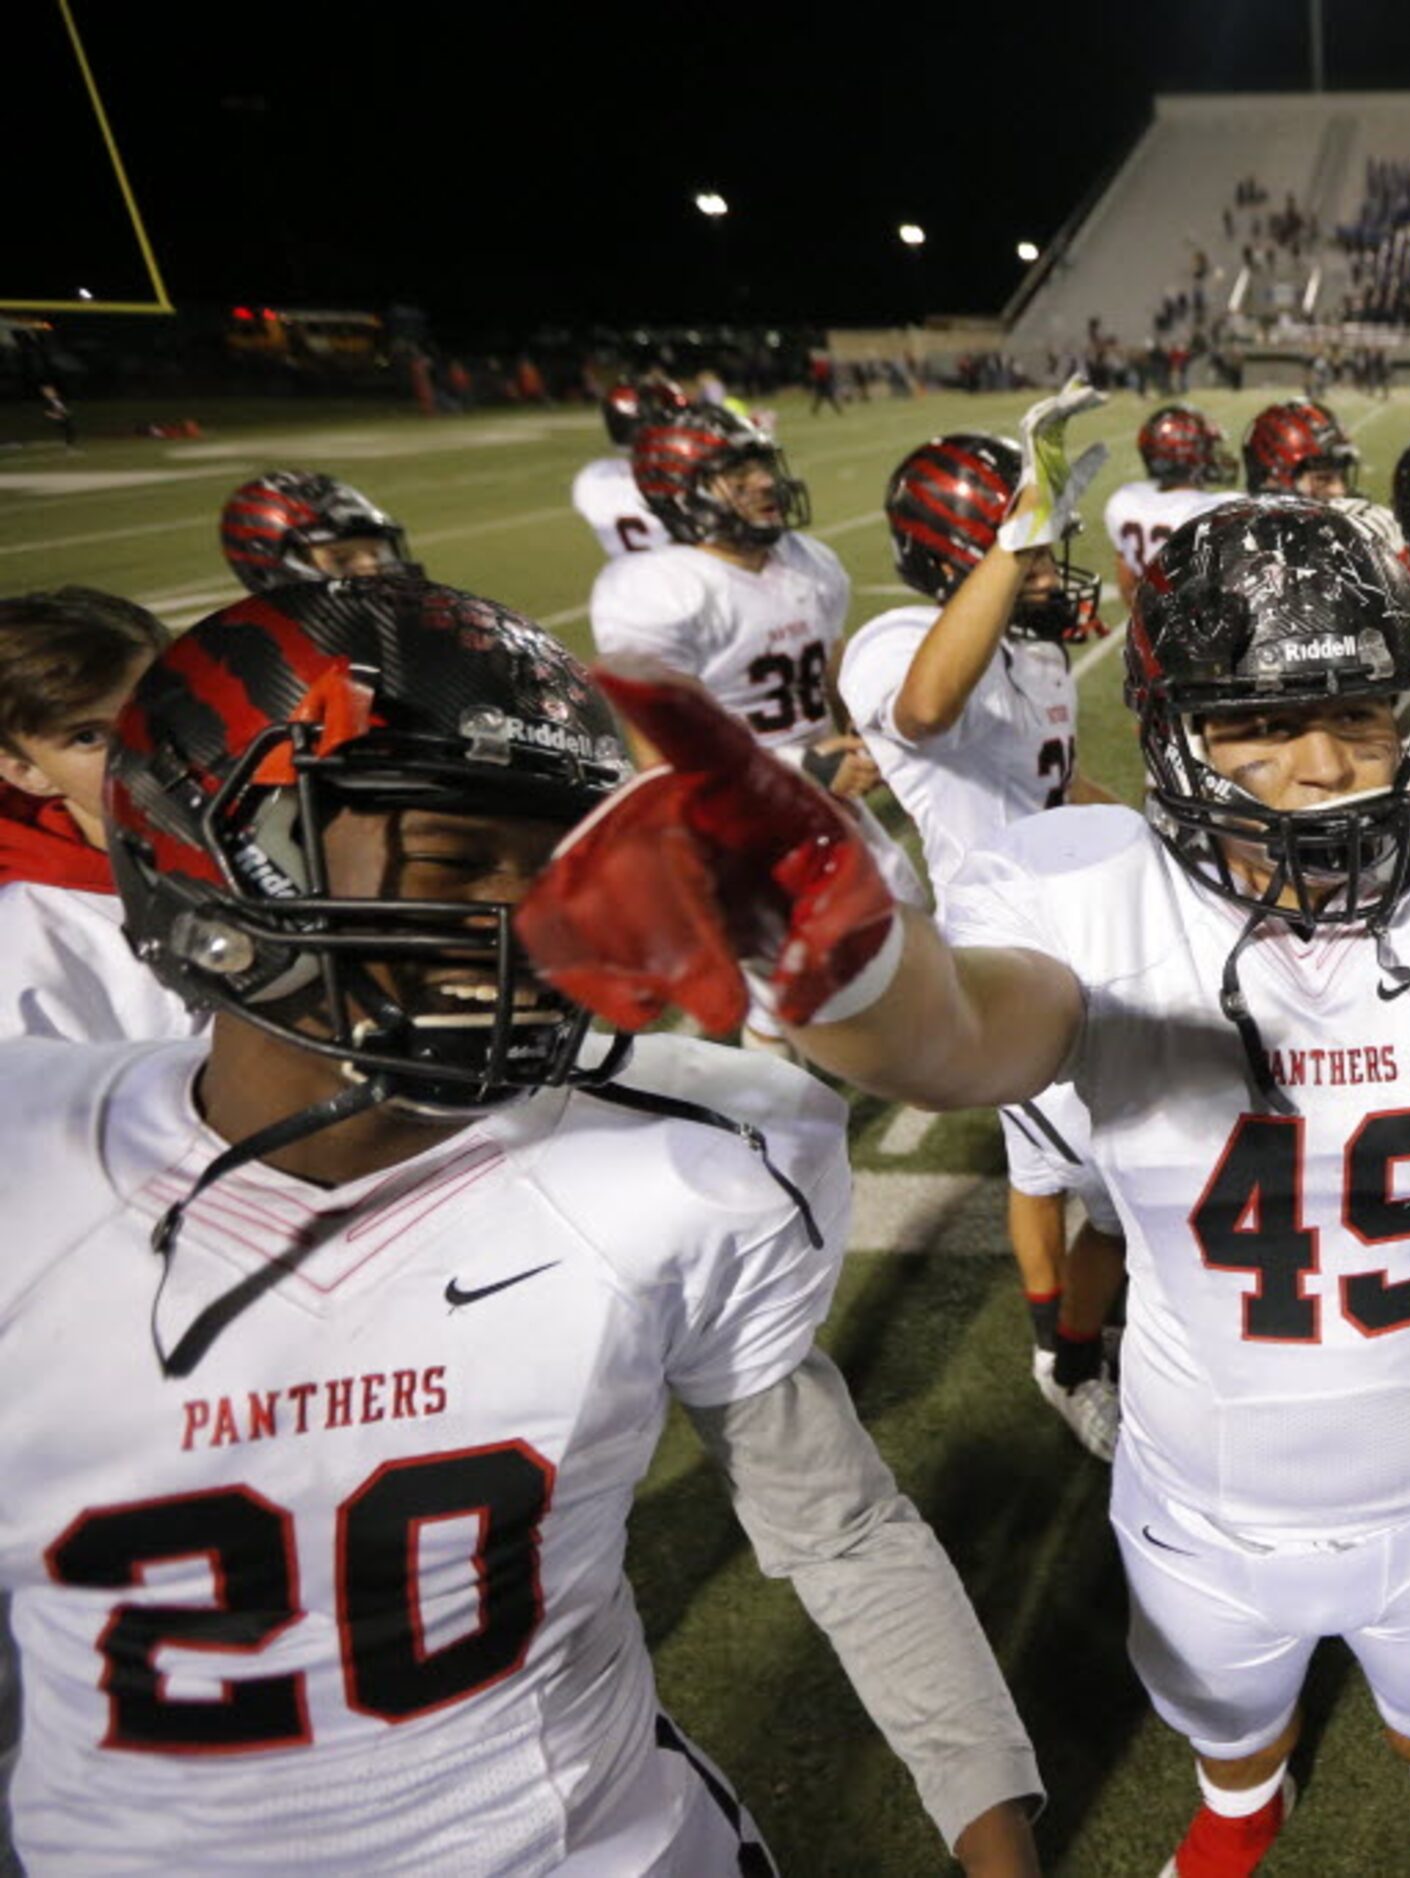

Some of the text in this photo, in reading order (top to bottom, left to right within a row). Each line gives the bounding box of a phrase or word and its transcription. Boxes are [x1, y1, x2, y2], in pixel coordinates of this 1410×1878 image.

[1284, 634, 1356, 661] Riddell
[506, 716, 594, 758] Riddell
[1262, 1045, 1398, 1086] ANTHERS
[181, 1365, 448, 1451] PANTHERS
[43, 1438, 556, 1756] 20
